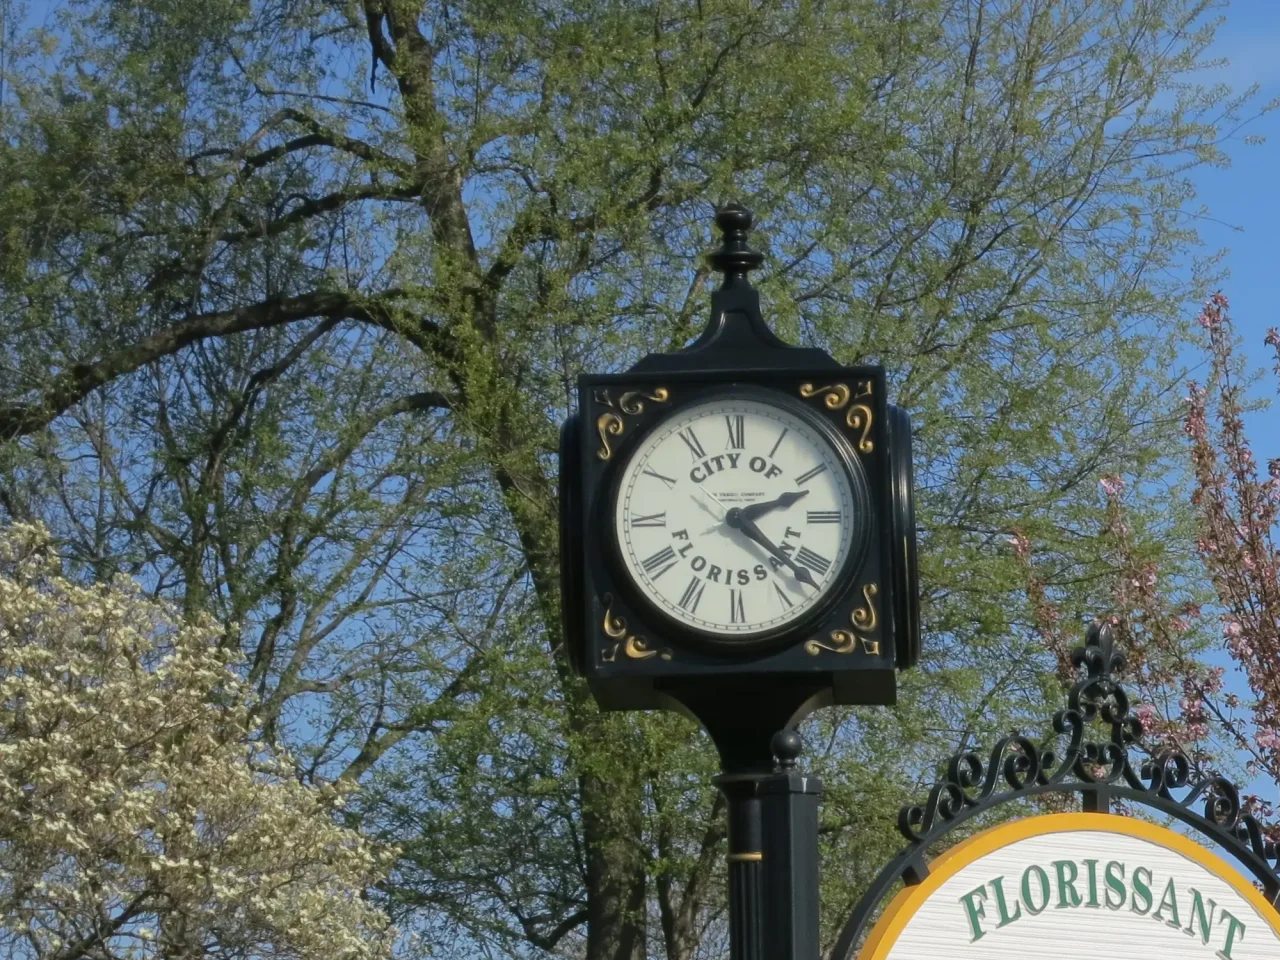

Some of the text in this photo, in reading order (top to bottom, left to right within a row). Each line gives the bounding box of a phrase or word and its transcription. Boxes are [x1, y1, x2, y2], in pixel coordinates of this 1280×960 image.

[689, 453, 783, 484] CITY OF
[671, 526, 802, 586] FLORISSANT
